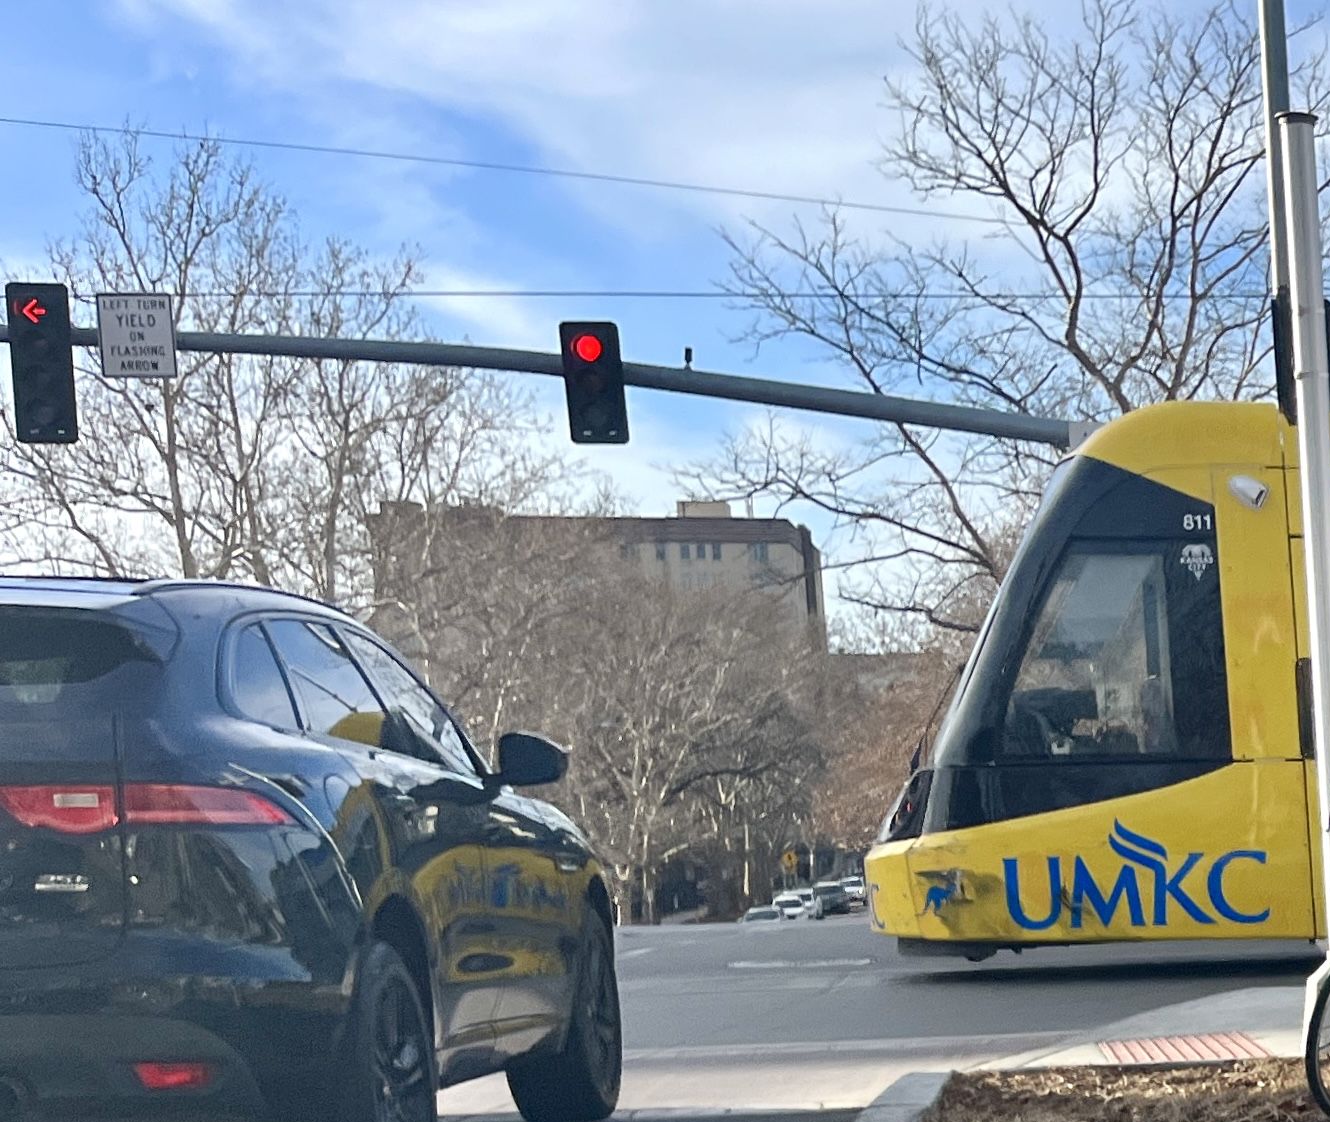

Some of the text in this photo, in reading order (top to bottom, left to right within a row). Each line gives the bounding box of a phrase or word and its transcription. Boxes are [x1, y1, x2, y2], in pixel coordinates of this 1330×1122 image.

[137, 300, 166, 310] TURN
[116, 314, 156, 328] YIELD
[130, 331, 145, 342] ON
[110, 345, 166, 357] FLASHING
[121, 360, 159, 371] ARROW
[1183, 514, 1211, 530] 811
[1003, 817, 1271, 930] UMKC
